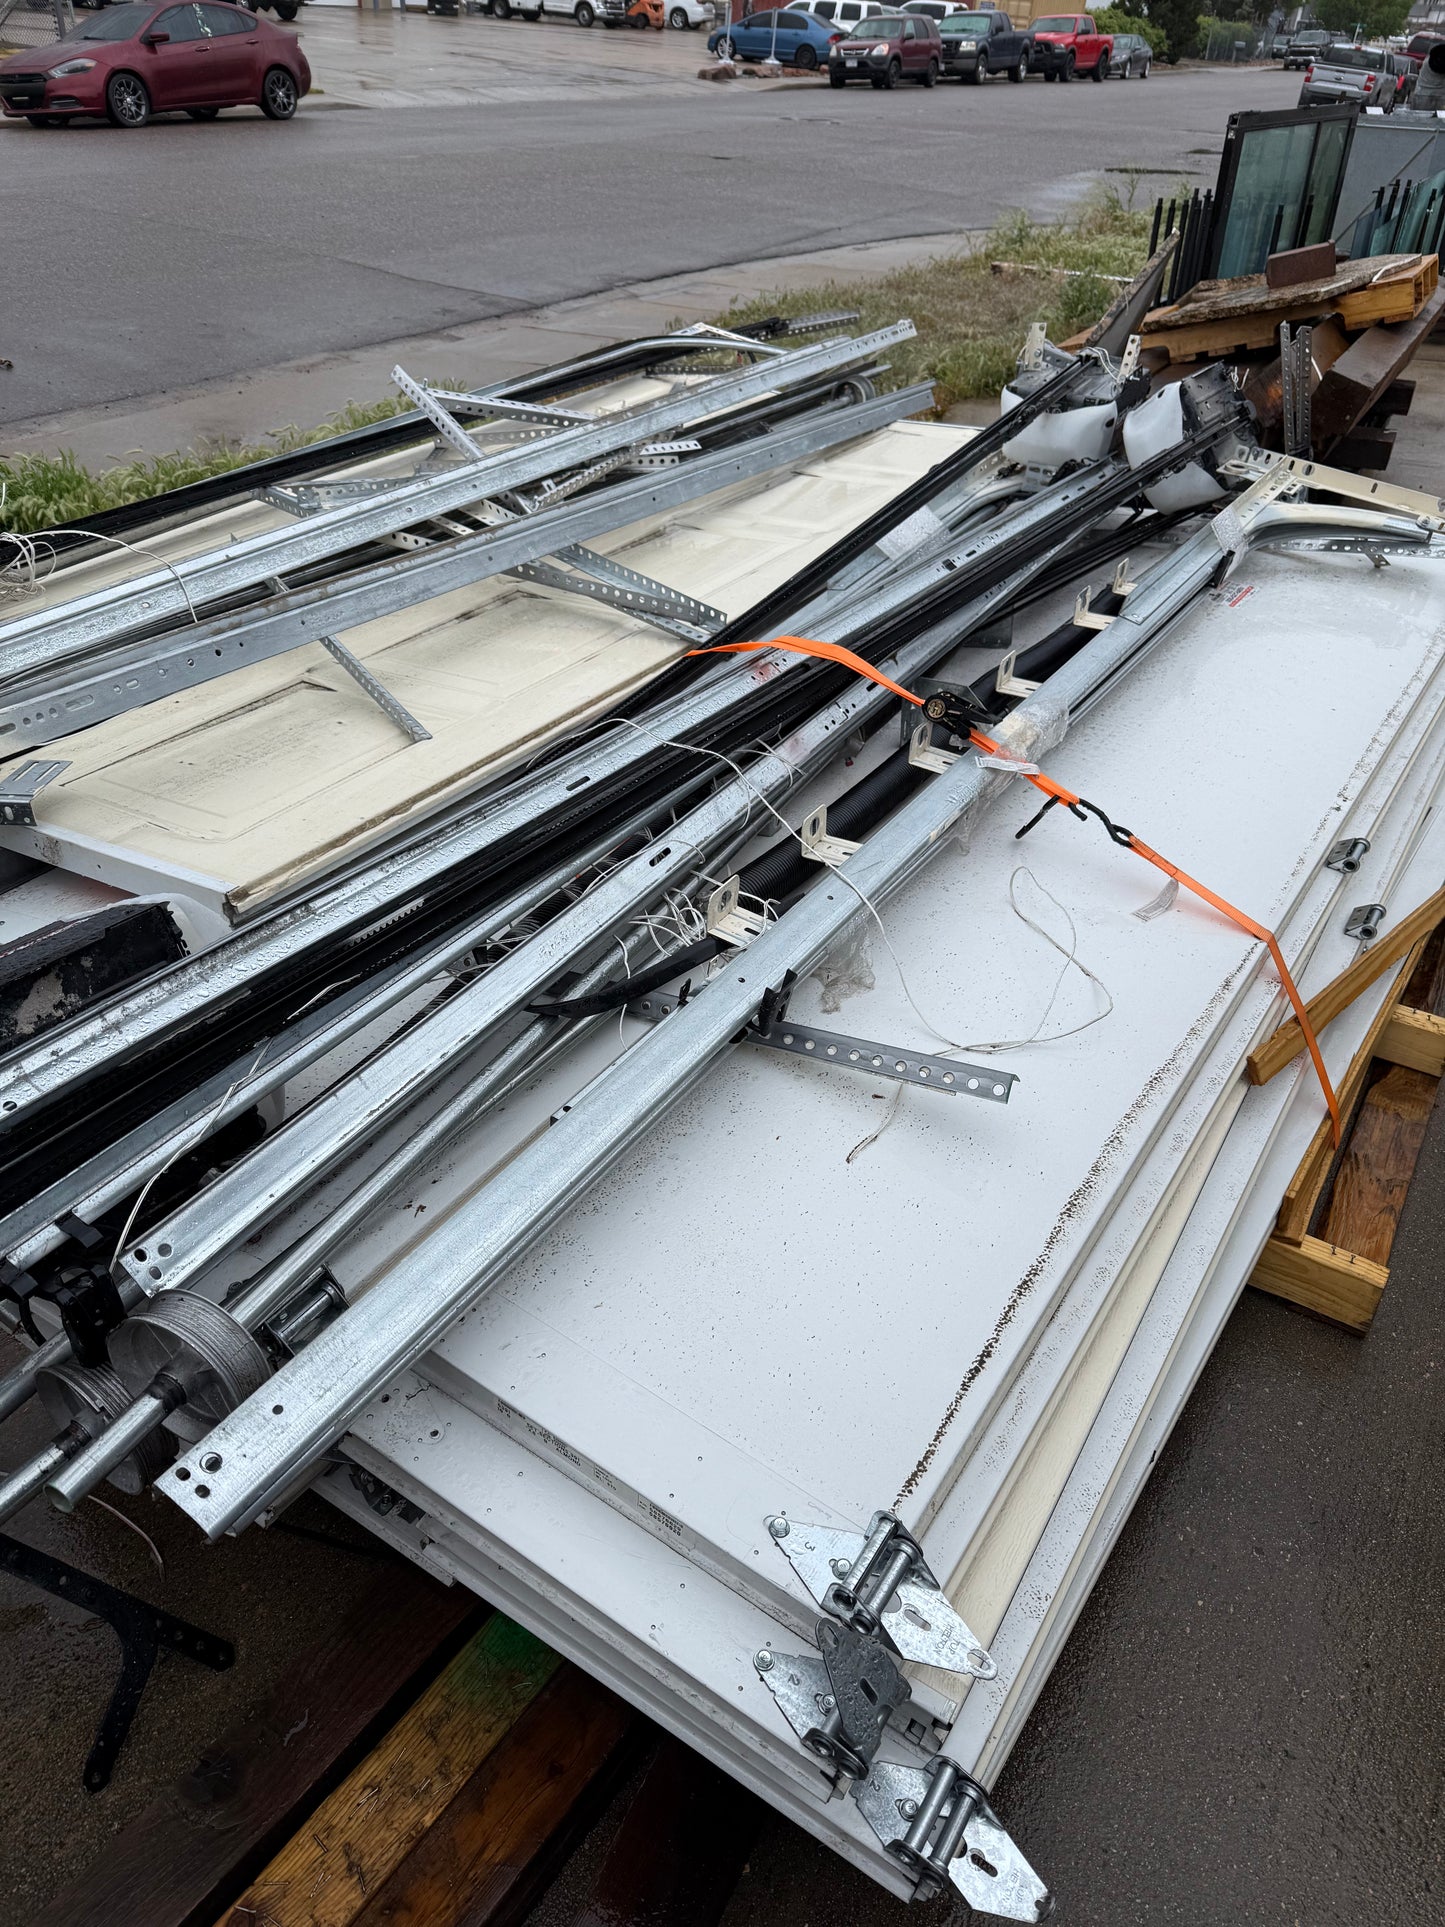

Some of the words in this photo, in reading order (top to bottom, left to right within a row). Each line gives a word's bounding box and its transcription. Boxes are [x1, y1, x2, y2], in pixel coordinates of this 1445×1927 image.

[804, 1541, 816, 1552] 3
[933, 1623, 956, 1657] HELTON
[949, 1638, 961, 1655] TOP
[787, 1673, 801, 1686] 2
[869, 1779, 881, 1791] 2
